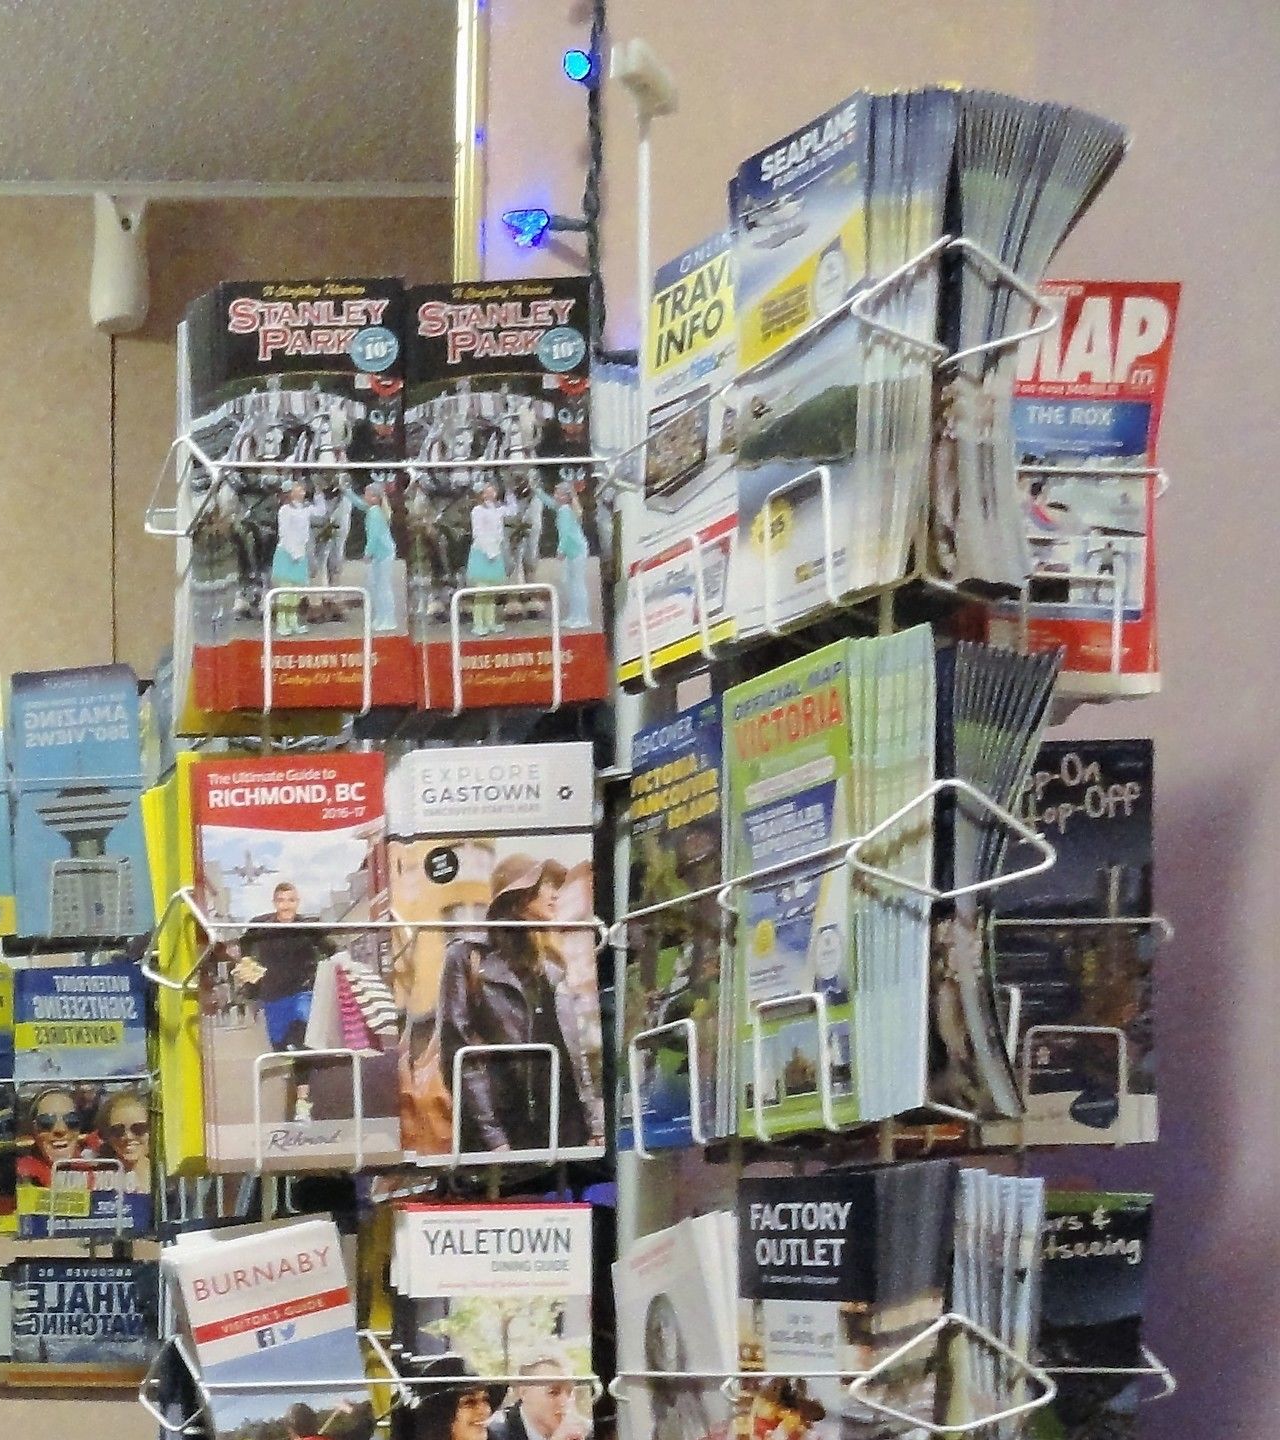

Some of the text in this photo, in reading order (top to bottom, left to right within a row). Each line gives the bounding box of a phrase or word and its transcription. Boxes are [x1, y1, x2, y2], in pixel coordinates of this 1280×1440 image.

[656, 254, 735, 329] TRAV
[228, 298, 390, 334] STANLEY
[417, 298, 576, 338] STANLEY
[258, 328, 358, 362] PARK
[446, 330, 546, 365] PARK
[654, 298, 724, 369] INFO
[734, 686, 842, 759] VICTORIA
[207, 772, 232, 786] The
[421, 763, 541, 784] EXPLORE
[1024, 752, 1101, 800] op-On
[207, 781, 366, 809] RICHMOND, BC
[421, 784, 541, 804] GASTOWN
[749, 1201, 853, 1231] FACTORY
[422, 1227, 572, 1256] YALETOWN
[755, 1237, 846, 1267] OUTLET
[191, 1245, 330, 1303] BURNABY
